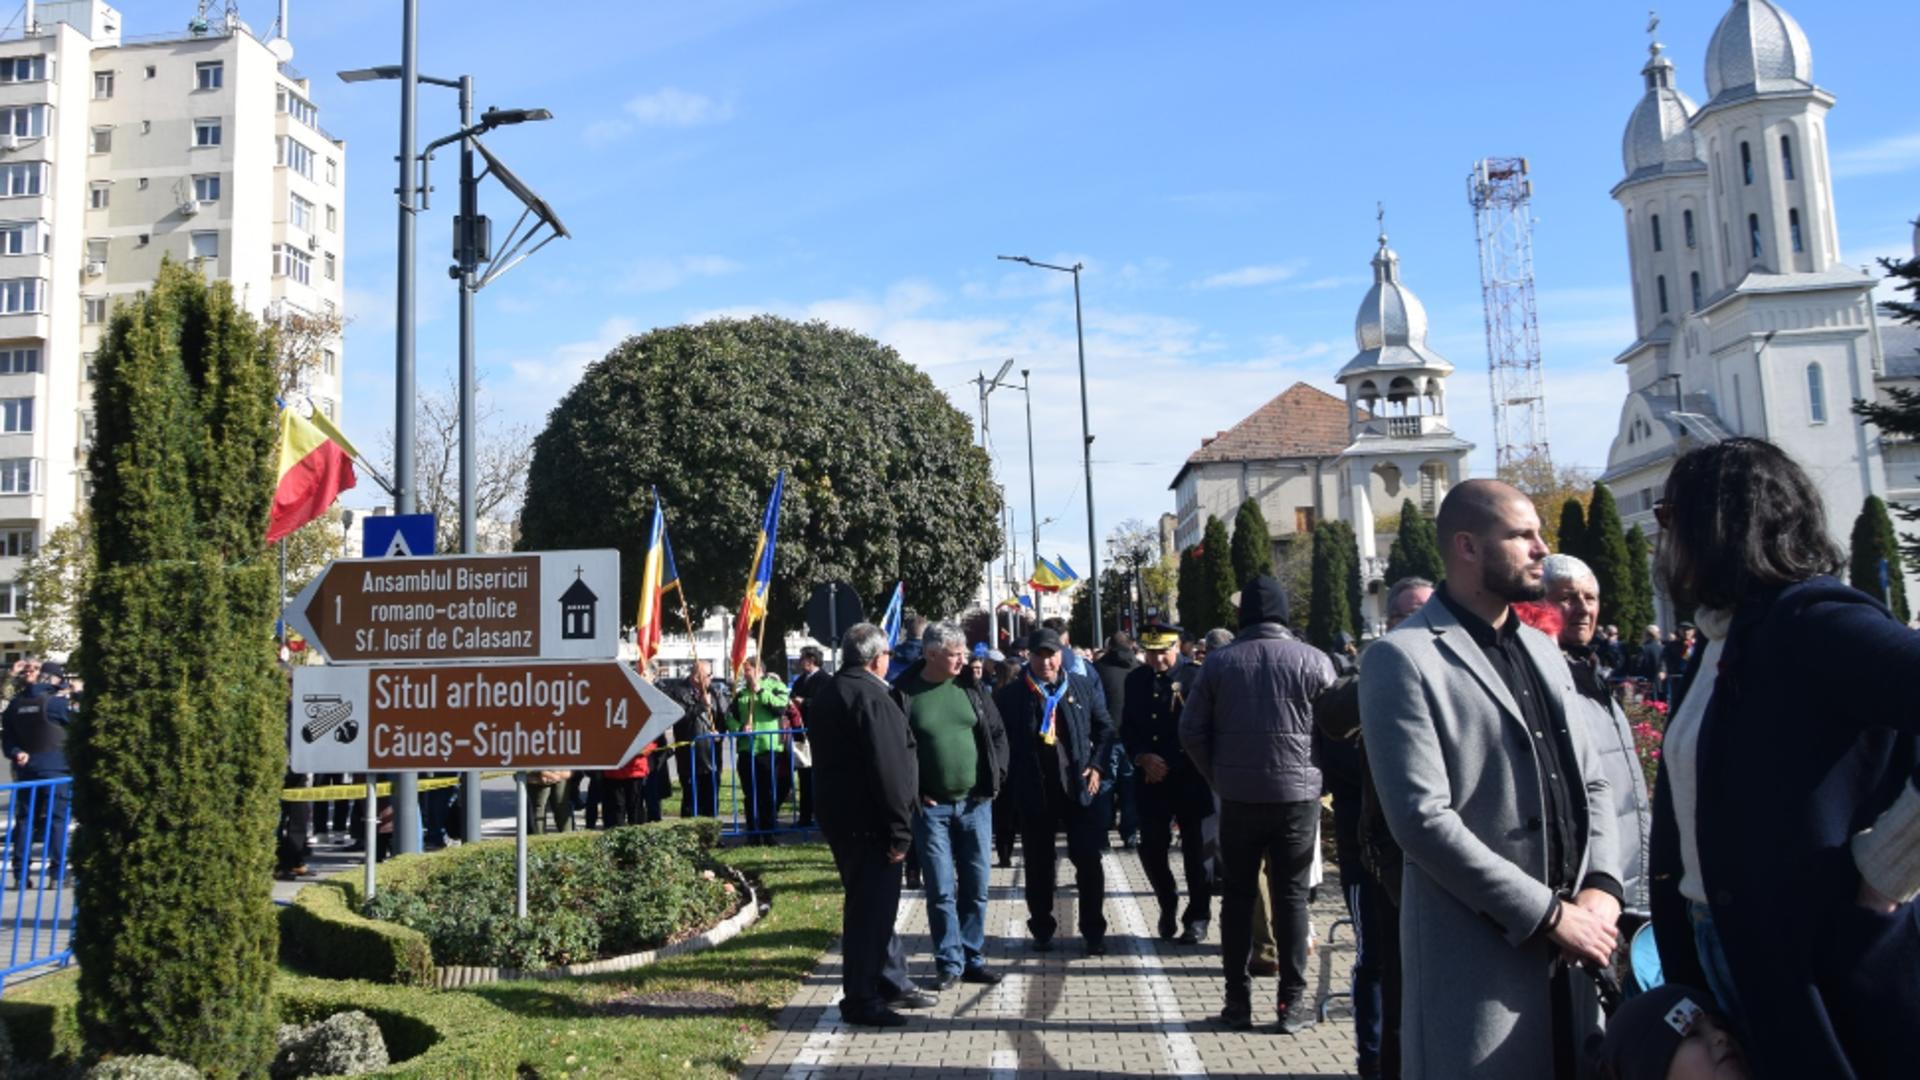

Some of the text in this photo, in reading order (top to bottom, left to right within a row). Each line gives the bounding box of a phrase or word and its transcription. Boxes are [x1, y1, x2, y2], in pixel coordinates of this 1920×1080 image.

[362, 566, 528, 593] Ansamblul Bisericii
[335, 595, 342, 625] 1
[371, 597, 518, 622] romano-catolice
[355, 626, 533, 651] Sf. Iosif de Calasanz
[375, 671, 591, 717] Situl arheologic
[605, 698, 628, 729] 14
